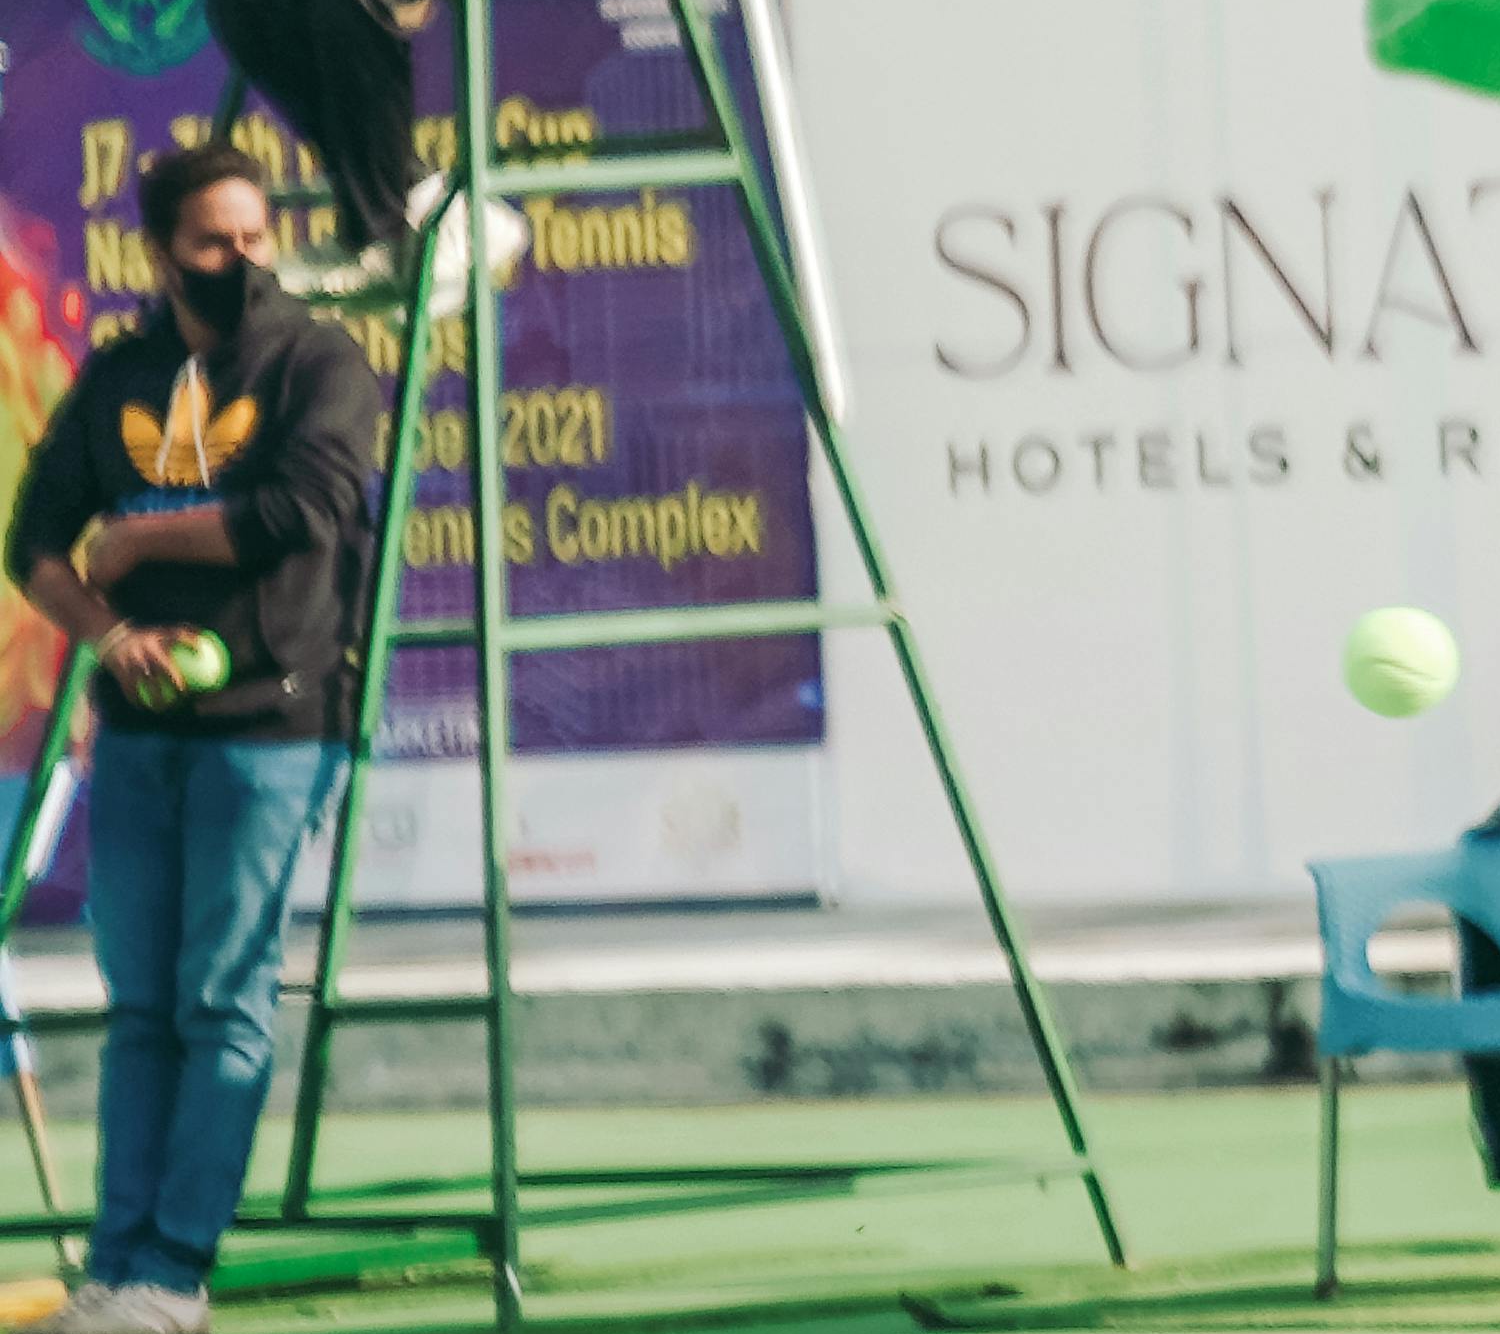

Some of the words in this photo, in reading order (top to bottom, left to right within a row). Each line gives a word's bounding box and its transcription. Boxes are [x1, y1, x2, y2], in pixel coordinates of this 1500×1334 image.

[524, 189, 690, 269] Tennis
[500, 384, 607, 468] 2021
[945, 419, 1290, 495] HOTELS
[1341, 421, 1387, 481] &
[546, 482, 762, 571] Complex
